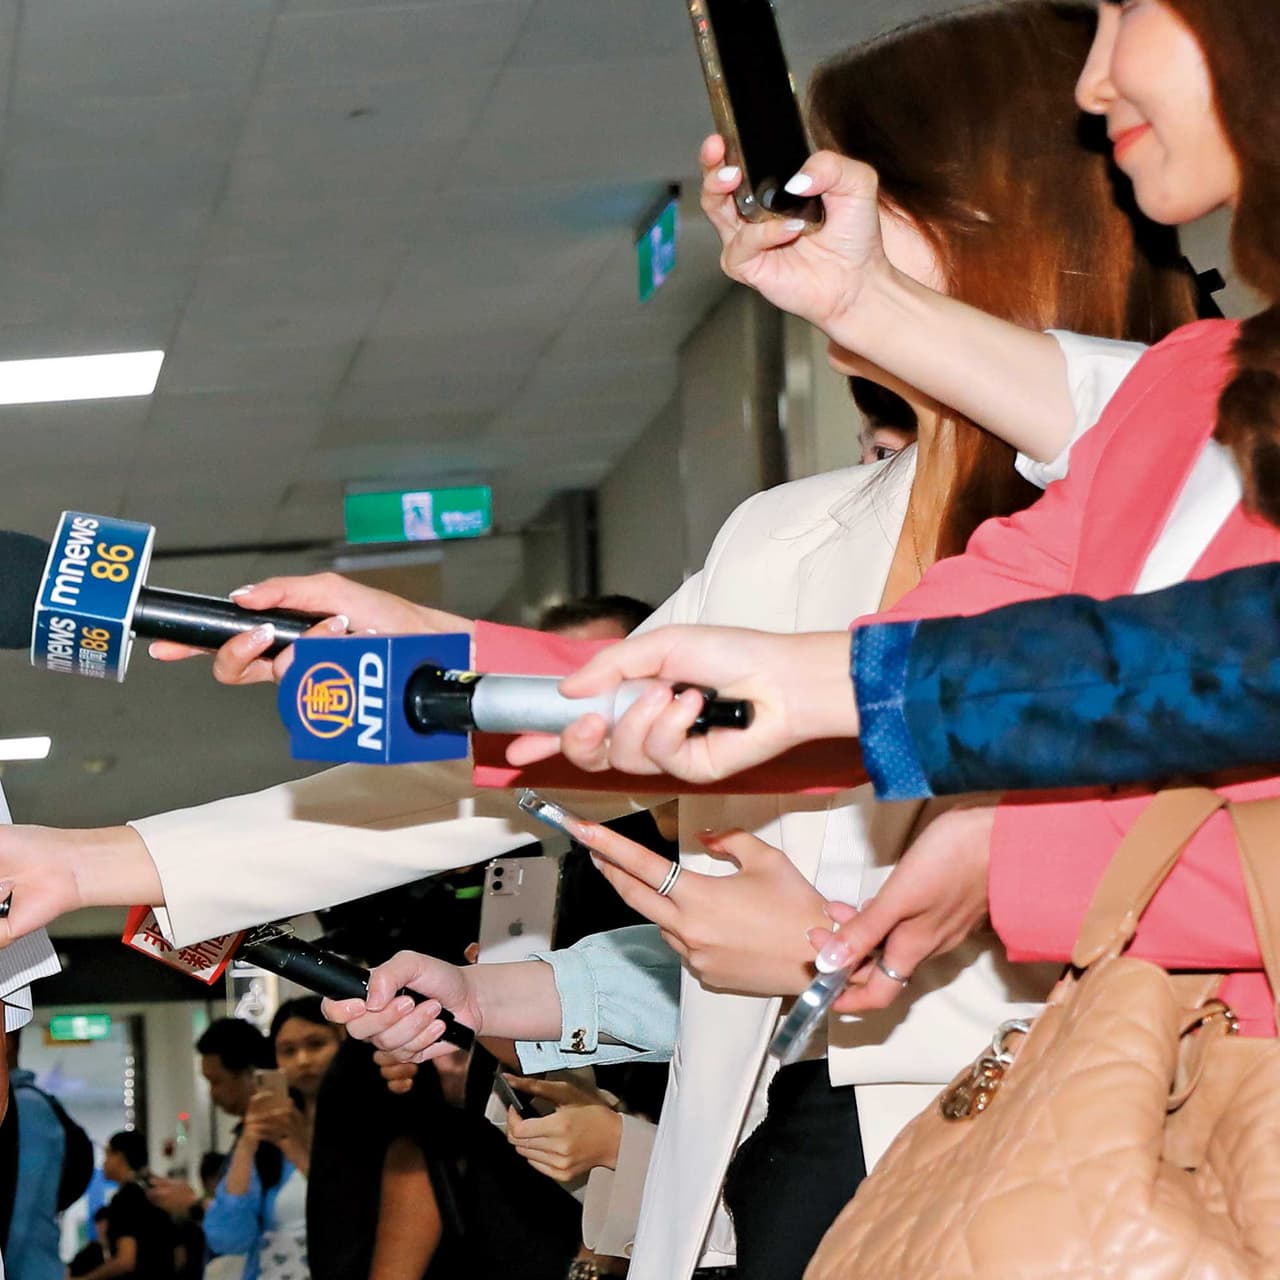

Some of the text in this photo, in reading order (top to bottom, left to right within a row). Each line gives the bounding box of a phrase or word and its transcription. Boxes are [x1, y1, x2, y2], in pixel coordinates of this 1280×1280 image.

[50, 516, 100, 606] mnews
[91, 542, 135, 582] 86
[79, 626, 111, 652] 86
[357, 652, 384, 751] NTD
[178, 934, 230, 971] 新
